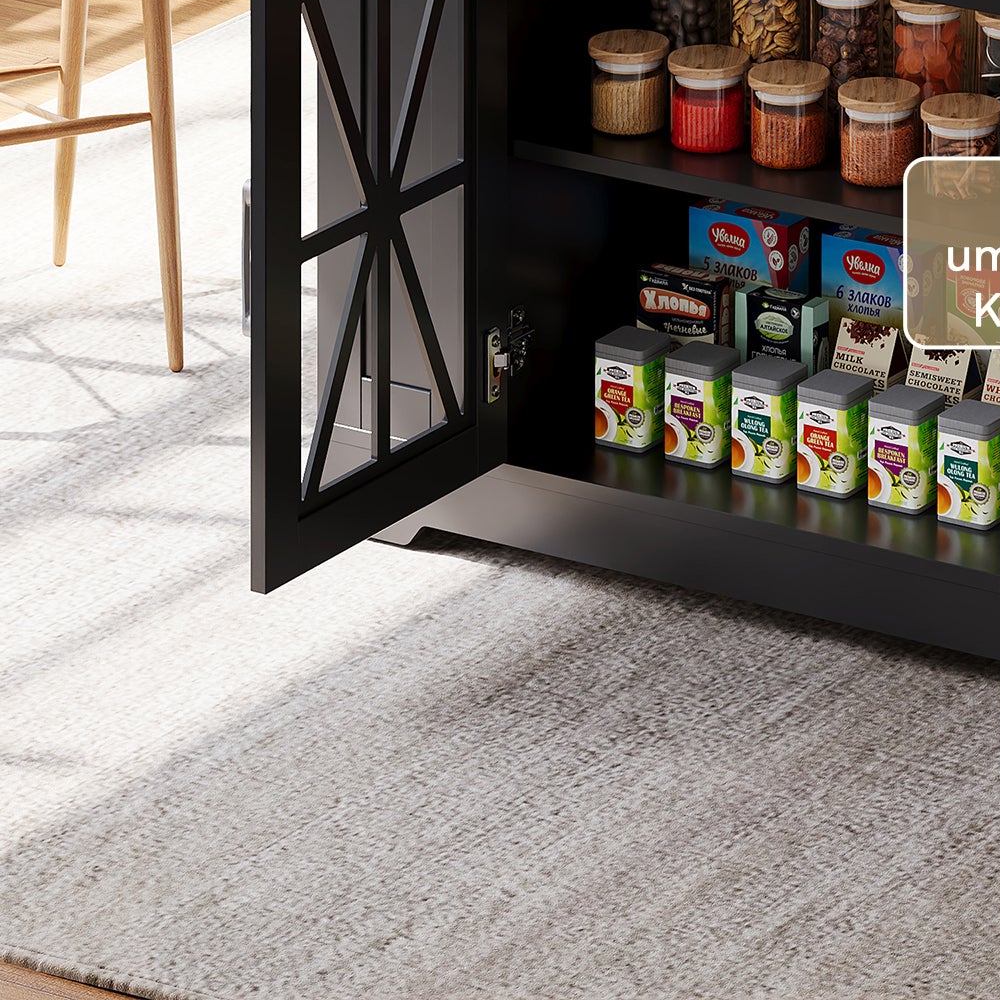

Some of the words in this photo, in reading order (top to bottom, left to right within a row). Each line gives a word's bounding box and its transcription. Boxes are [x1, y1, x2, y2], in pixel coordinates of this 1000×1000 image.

[703, 256, 710, 271] 5
[713, 261, 758, 281] злаков
[836, 284, 844, 299] 6
[847, 289, 892, 308] злаков
[835, 352, 864, 365] MILK
[833, 361, 887, 378] CHOCOLATE
[909, 370, 962, 386] SEMISWEET
[907, 378, 961, 395] CHOCOLATE
[604, 392, 620, 401] GREEN
[759, 426, 769, 434] TEA
[806, 437, 823, 446] GREEN
[965, 472, 976, 480] TEA
